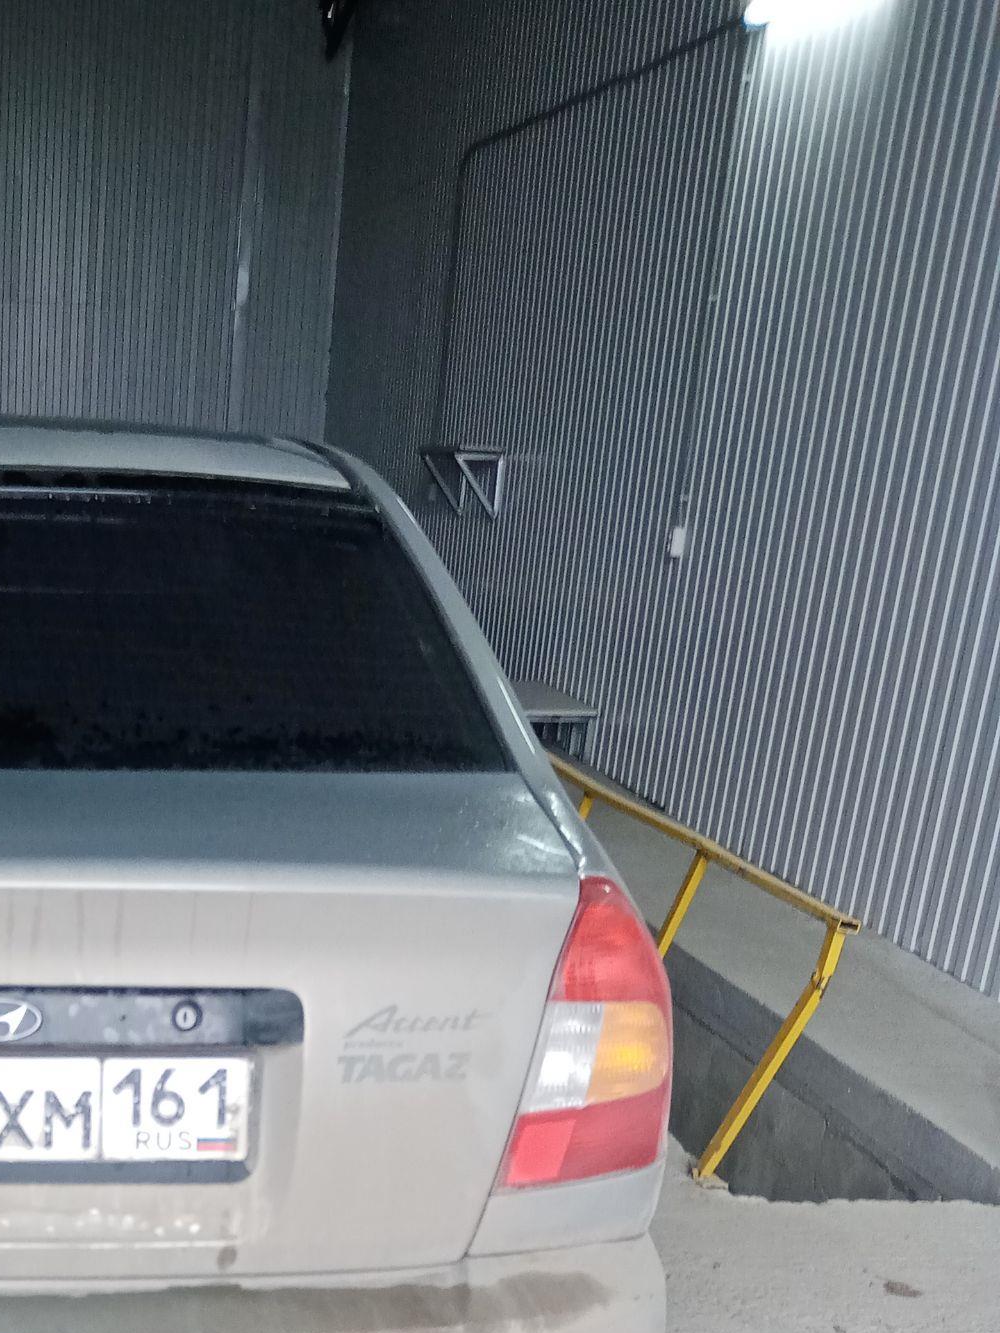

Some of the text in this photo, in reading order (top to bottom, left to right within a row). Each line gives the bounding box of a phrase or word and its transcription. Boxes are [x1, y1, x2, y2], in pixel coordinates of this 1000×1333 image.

[342, 1003, 494, 1038] Accent
[337, 1052, 473, 1084] TAGAZ
[112, 1067, 229, 1129] 161
[136, 1131, 193, 1151] RUS
